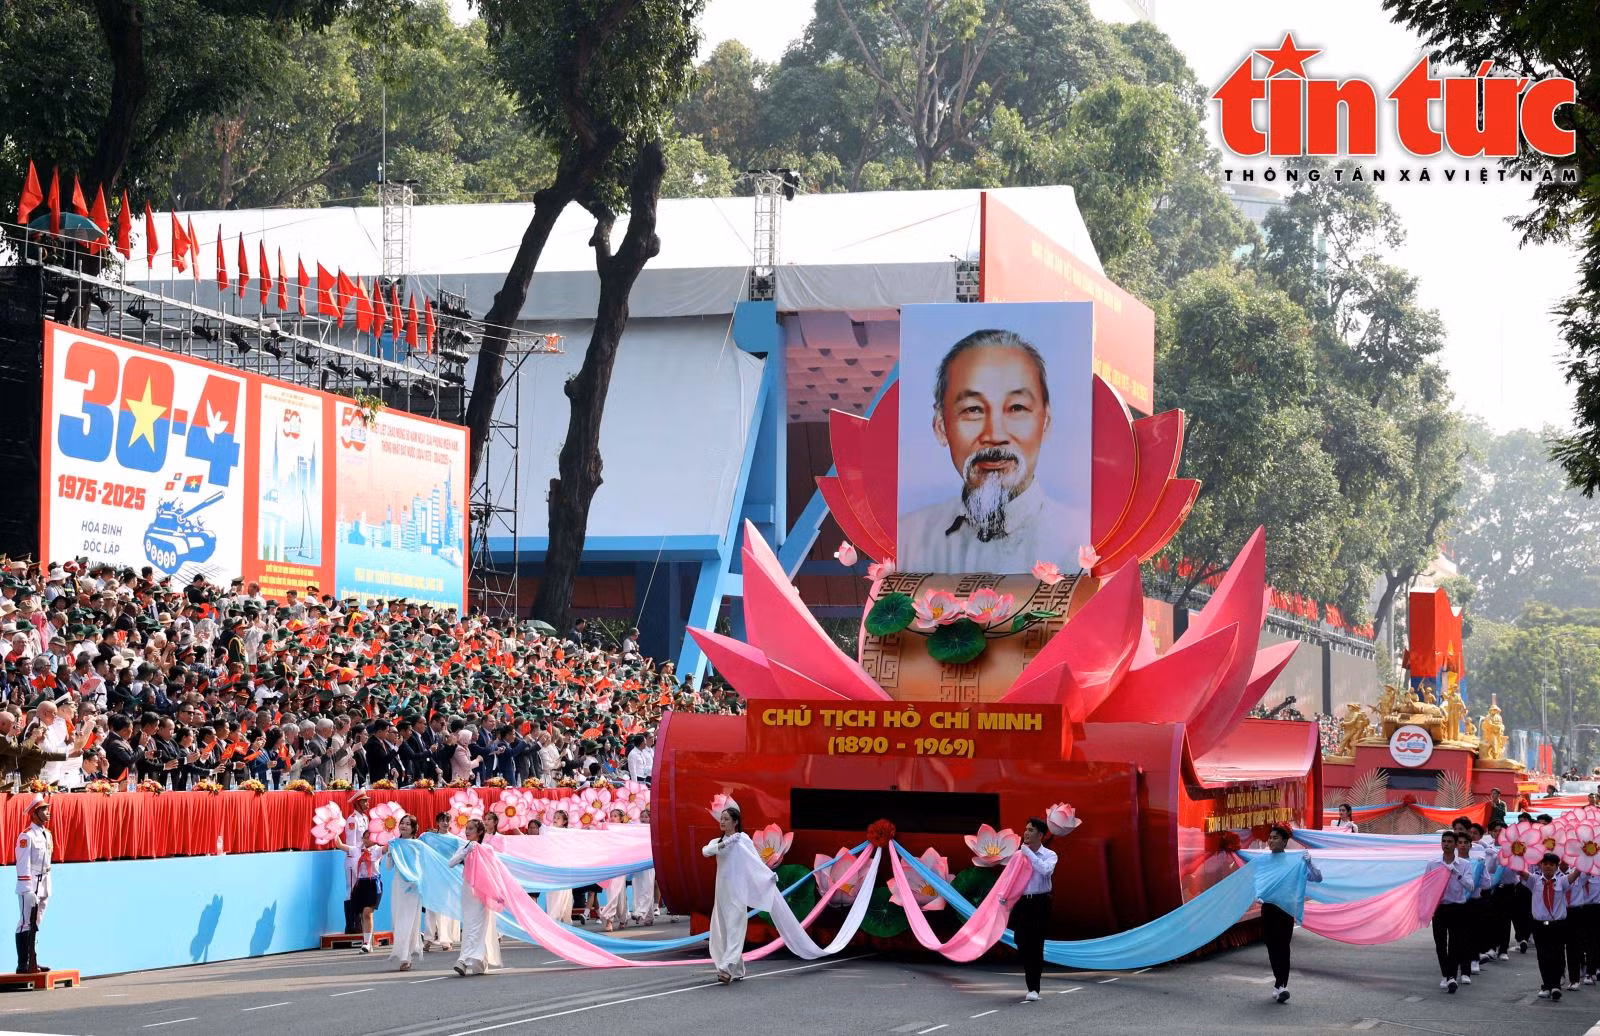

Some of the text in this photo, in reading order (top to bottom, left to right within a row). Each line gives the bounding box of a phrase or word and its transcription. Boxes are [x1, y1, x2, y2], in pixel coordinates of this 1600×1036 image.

[58, 341, 240, 487] 30-4
[762, 704, 1042, 731] CHỦ TỊCH HỒ CHÍ MINH
[828, 736, 888, 755] (1890
[914, 737, 975, 759] 1969)
